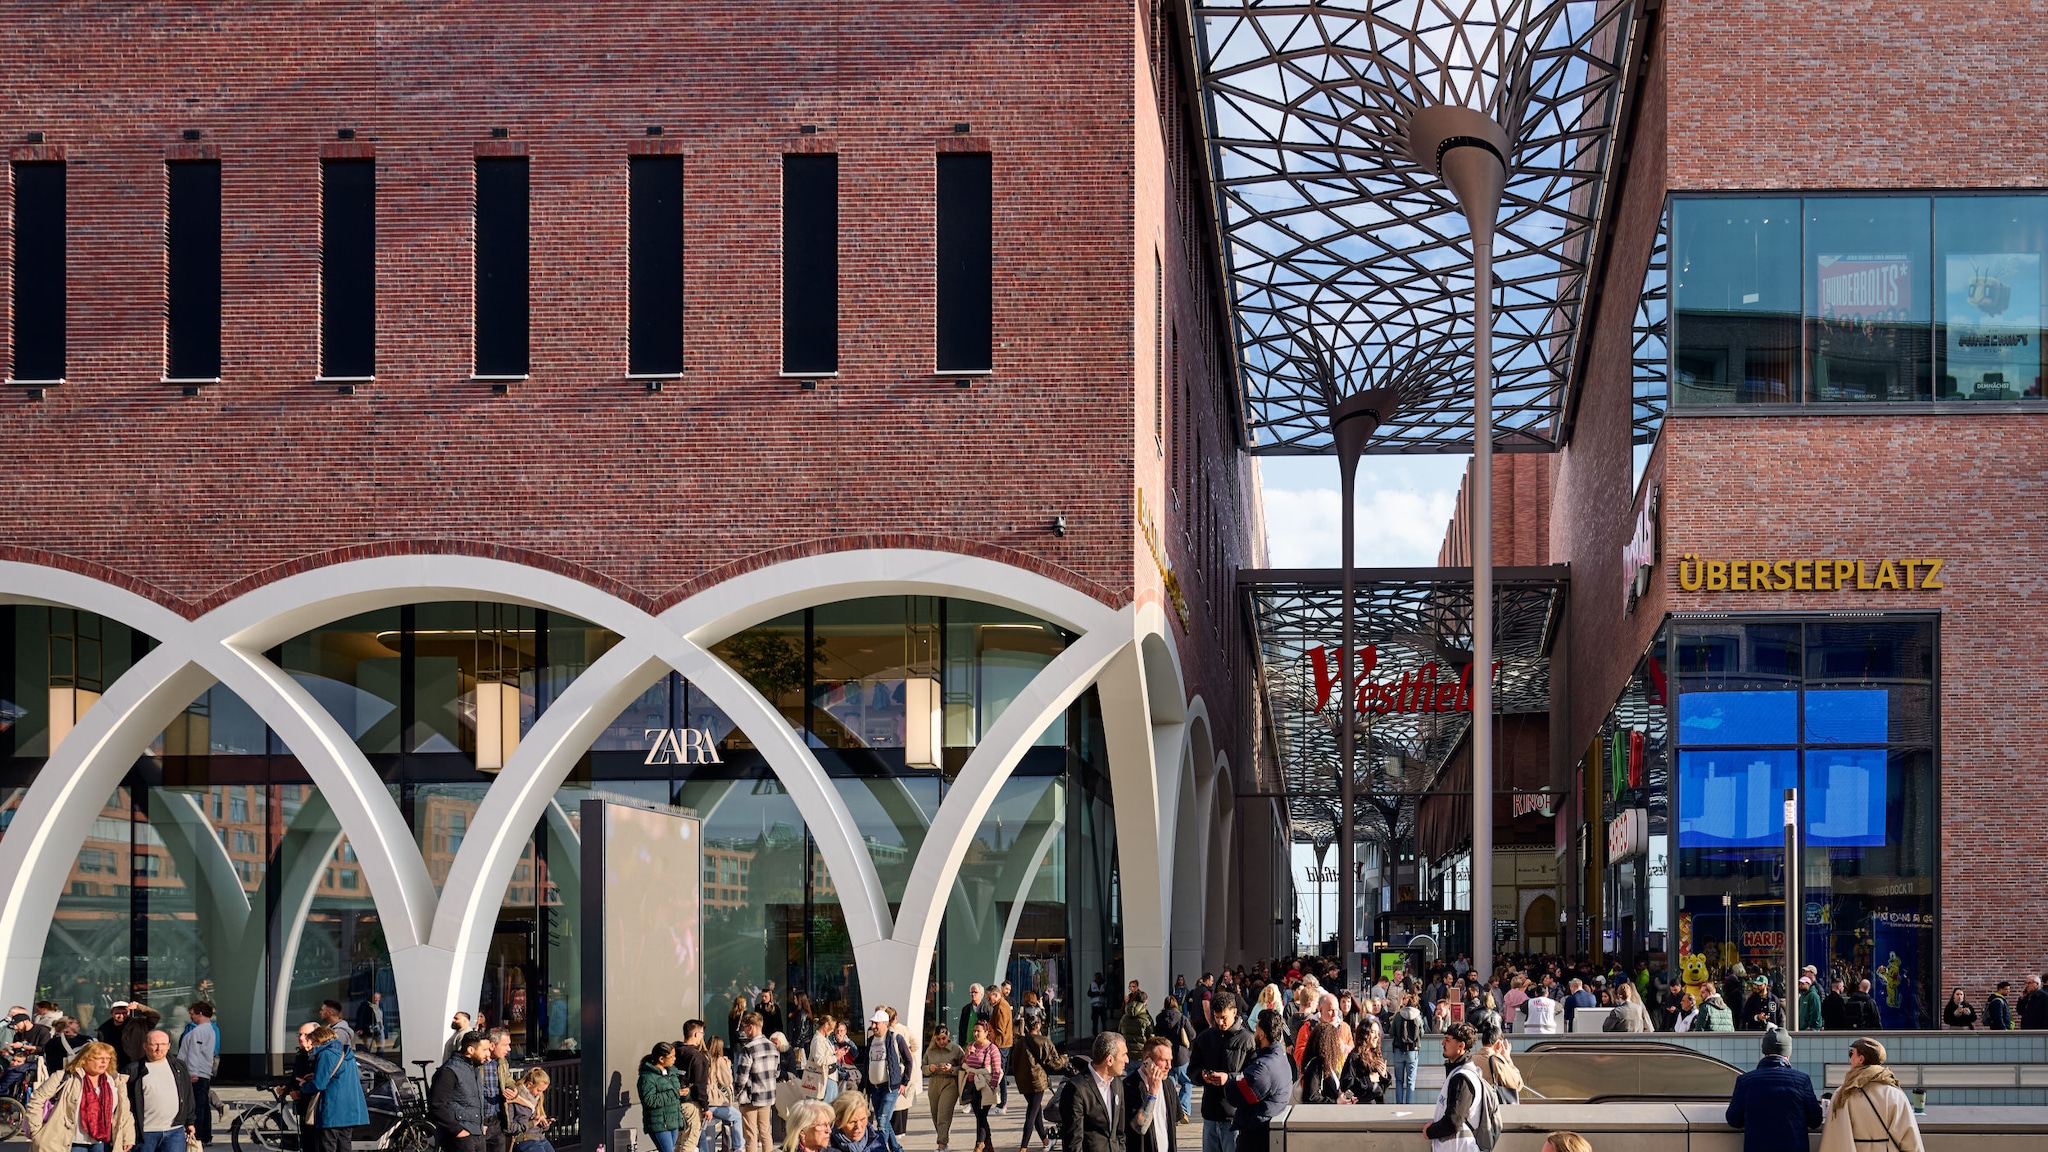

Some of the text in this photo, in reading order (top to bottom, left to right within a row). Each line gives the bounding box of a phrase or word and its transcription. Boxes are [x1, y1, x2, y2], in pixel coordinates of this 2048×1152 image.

[1679, 553, 1944, 591] ÜBERSEEPLATZ
[644, 728, 724, 765] ZARA
[1743, 931, 1785, 947] HARIB
